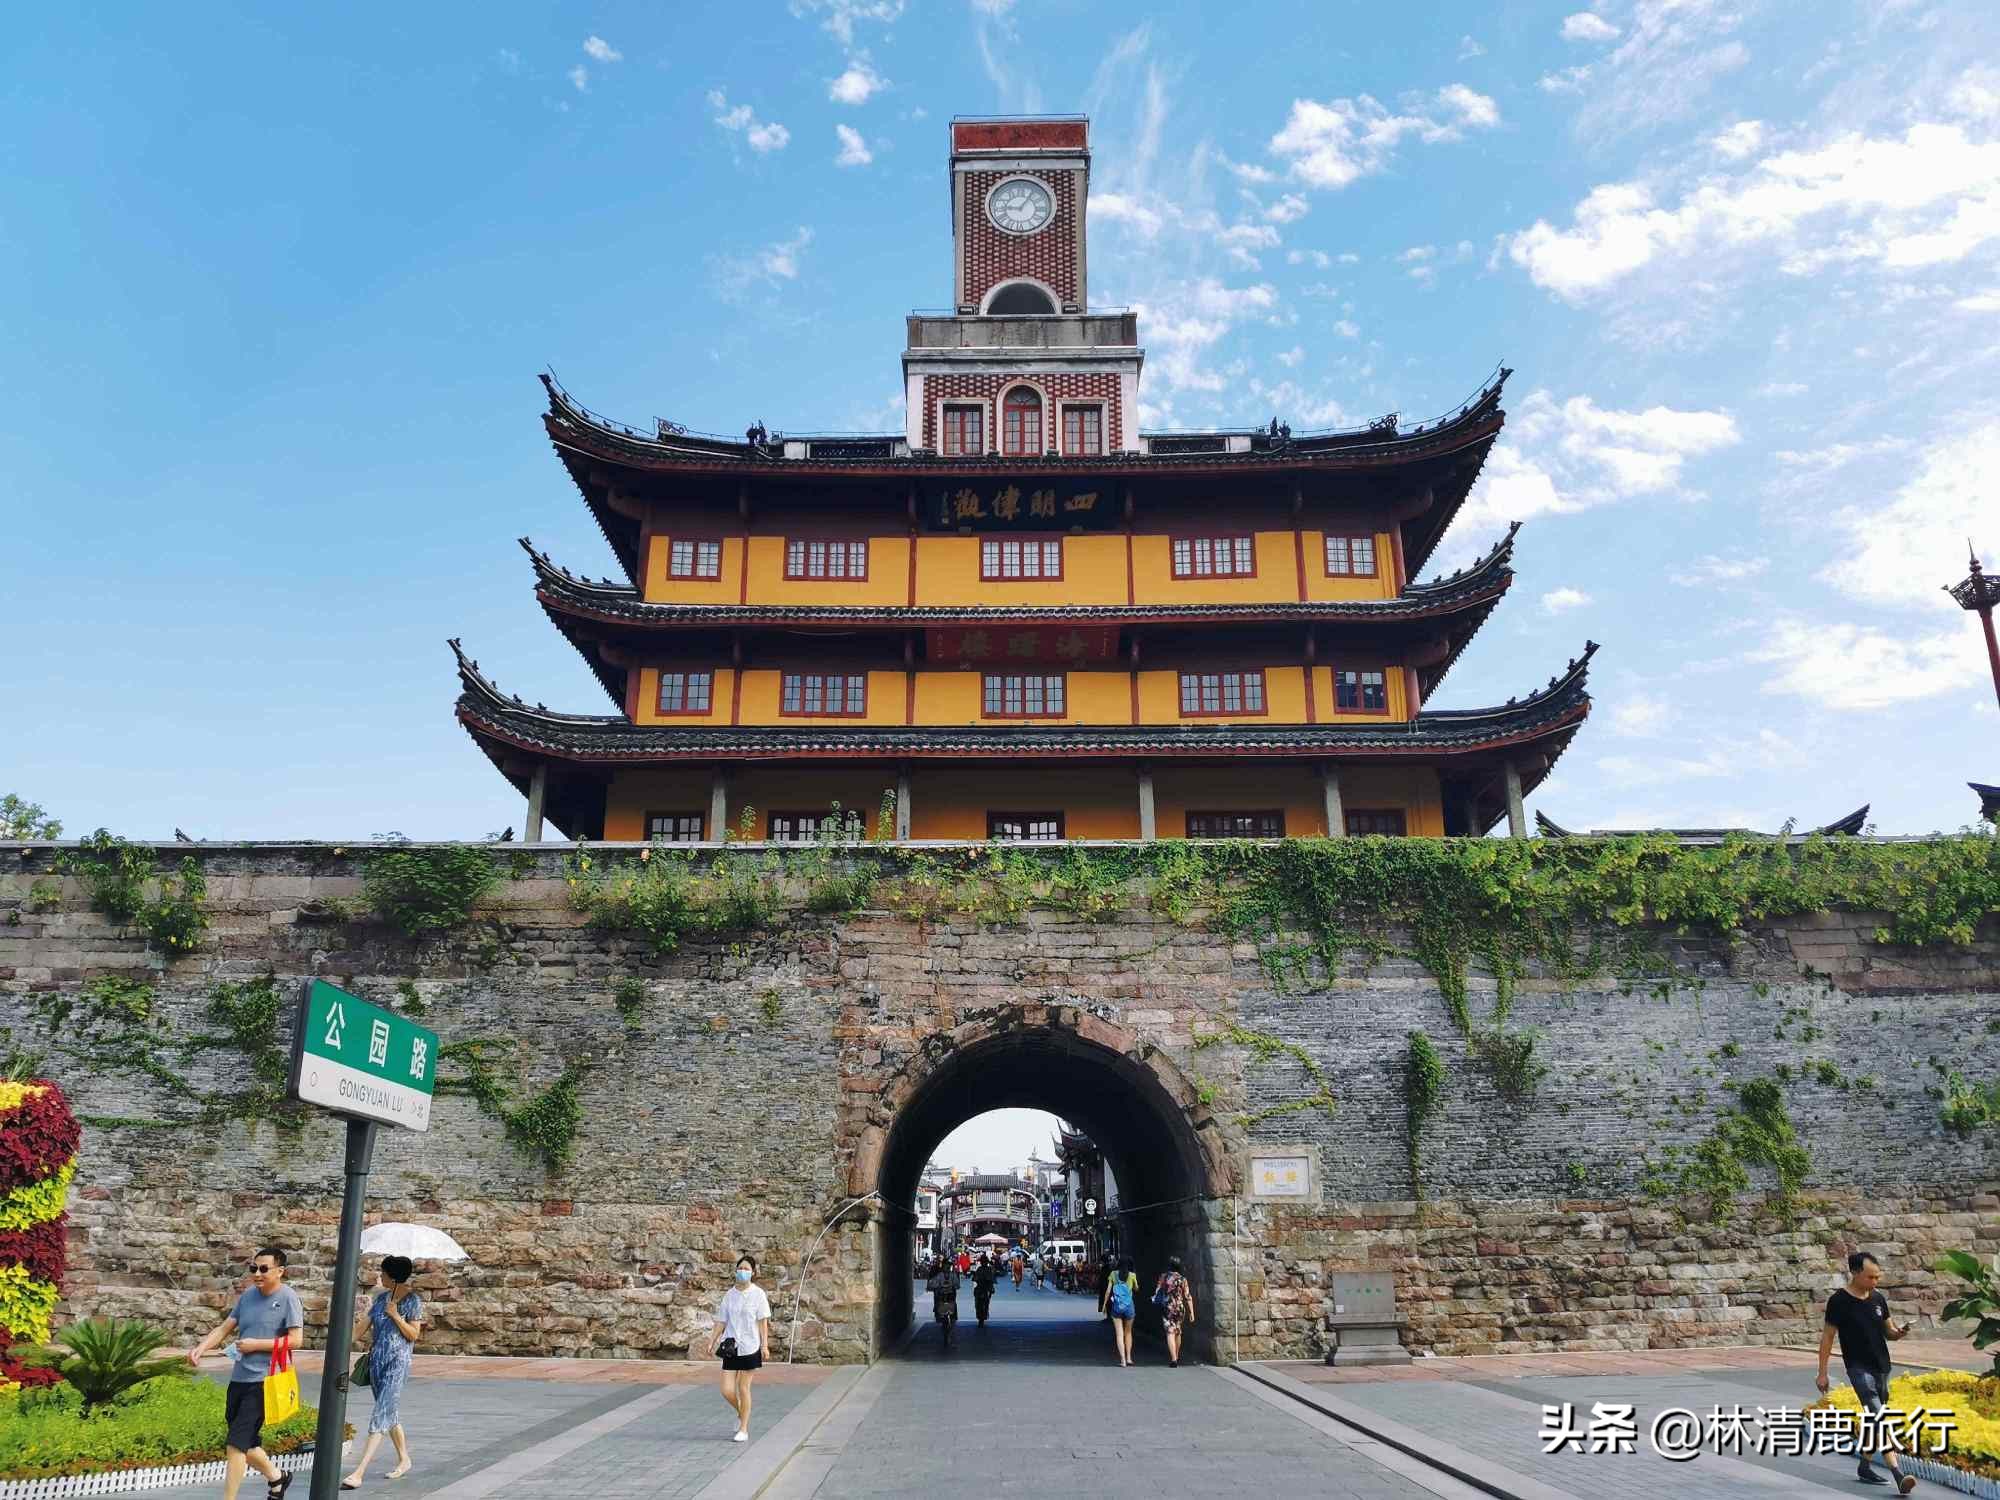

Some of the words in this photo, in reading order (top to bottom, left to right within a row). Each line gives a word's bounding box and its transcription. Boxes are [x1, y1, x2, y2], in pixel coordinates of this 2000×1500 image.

[325, 1001, 428, 1081] 公园路
[339, 1078, 390, 1109] GONGYUAN
[391, 1096, 403, 1112] LU
